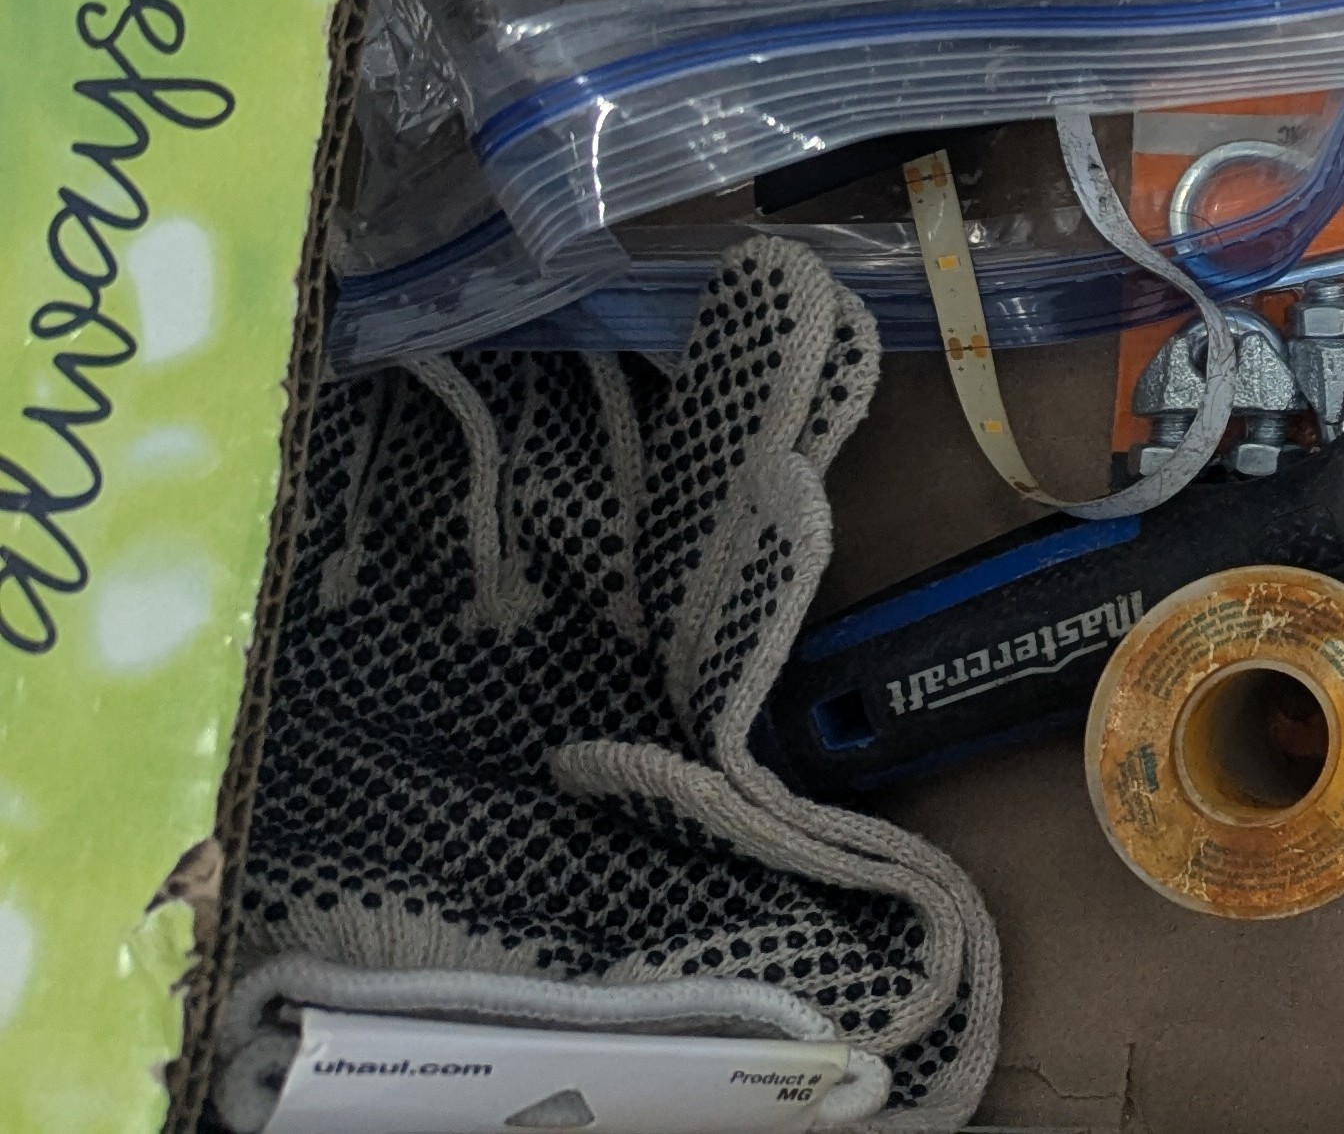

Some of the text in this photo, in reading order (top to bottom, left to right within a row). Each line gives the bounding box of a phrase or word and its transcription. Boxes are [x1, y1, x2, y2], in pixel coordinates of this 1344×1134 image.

[886, 590, 1156, 716] Mastercraft
[312, 1059, 493, 1079] uhaul.com
[729, 1069, 805, 1088] Product
[776, 1086, 814, 1103] MG
